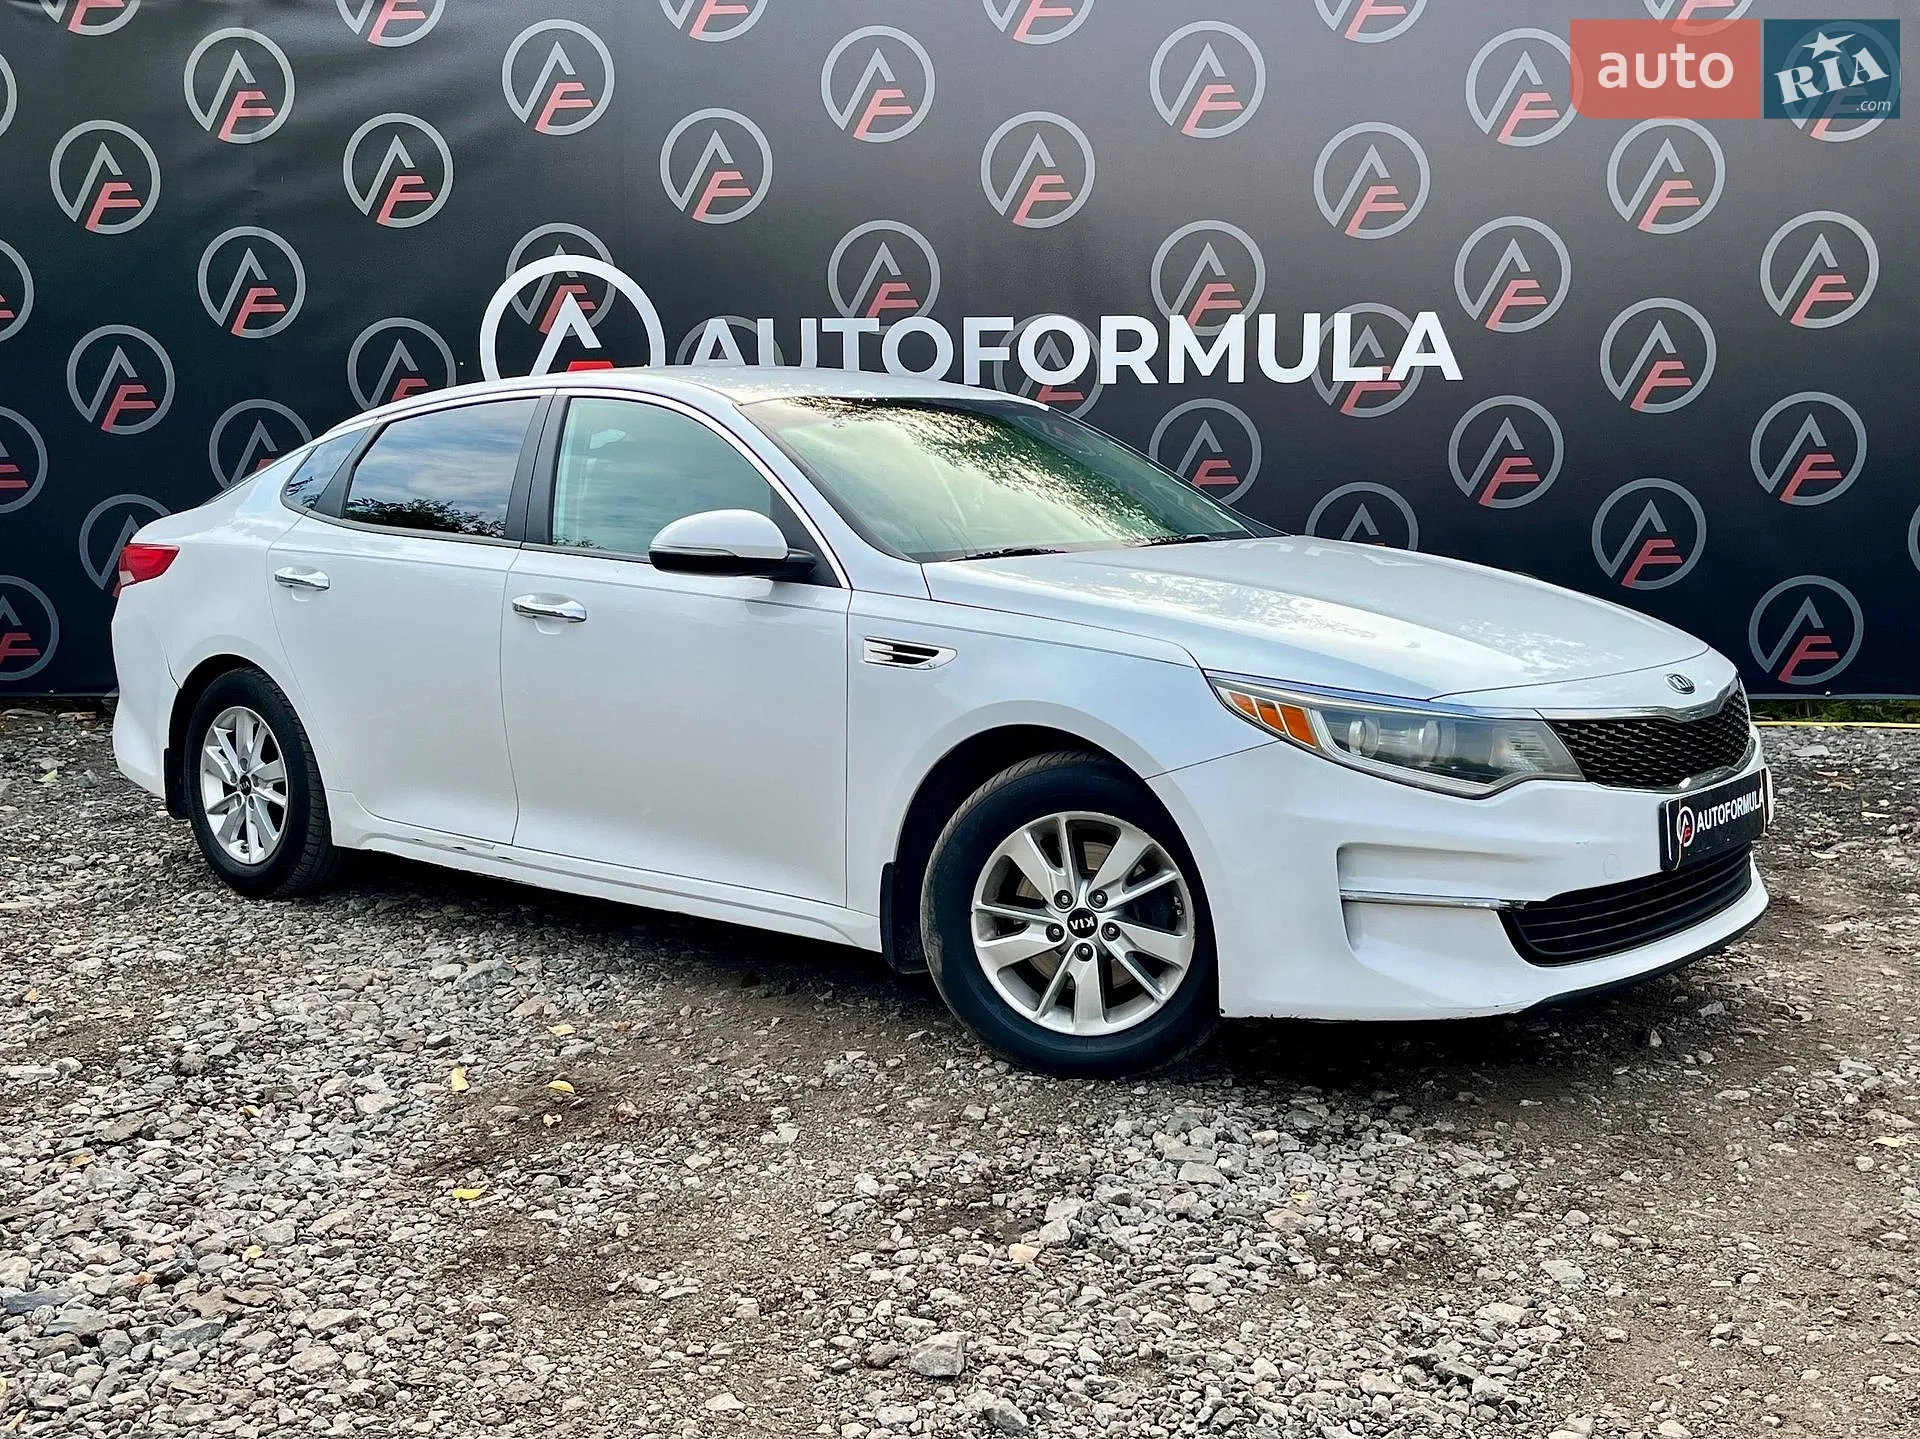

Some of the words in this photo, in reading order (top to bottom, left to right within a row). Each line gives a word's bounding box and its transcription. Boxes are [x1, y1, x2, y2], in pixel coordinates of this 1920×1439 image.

[691, 311, 1464, 386] AUTOFORMULA
[1696, 788, 1764, 833] AUTOFORMULA
[1070, 917, 1095, 930] KIA
